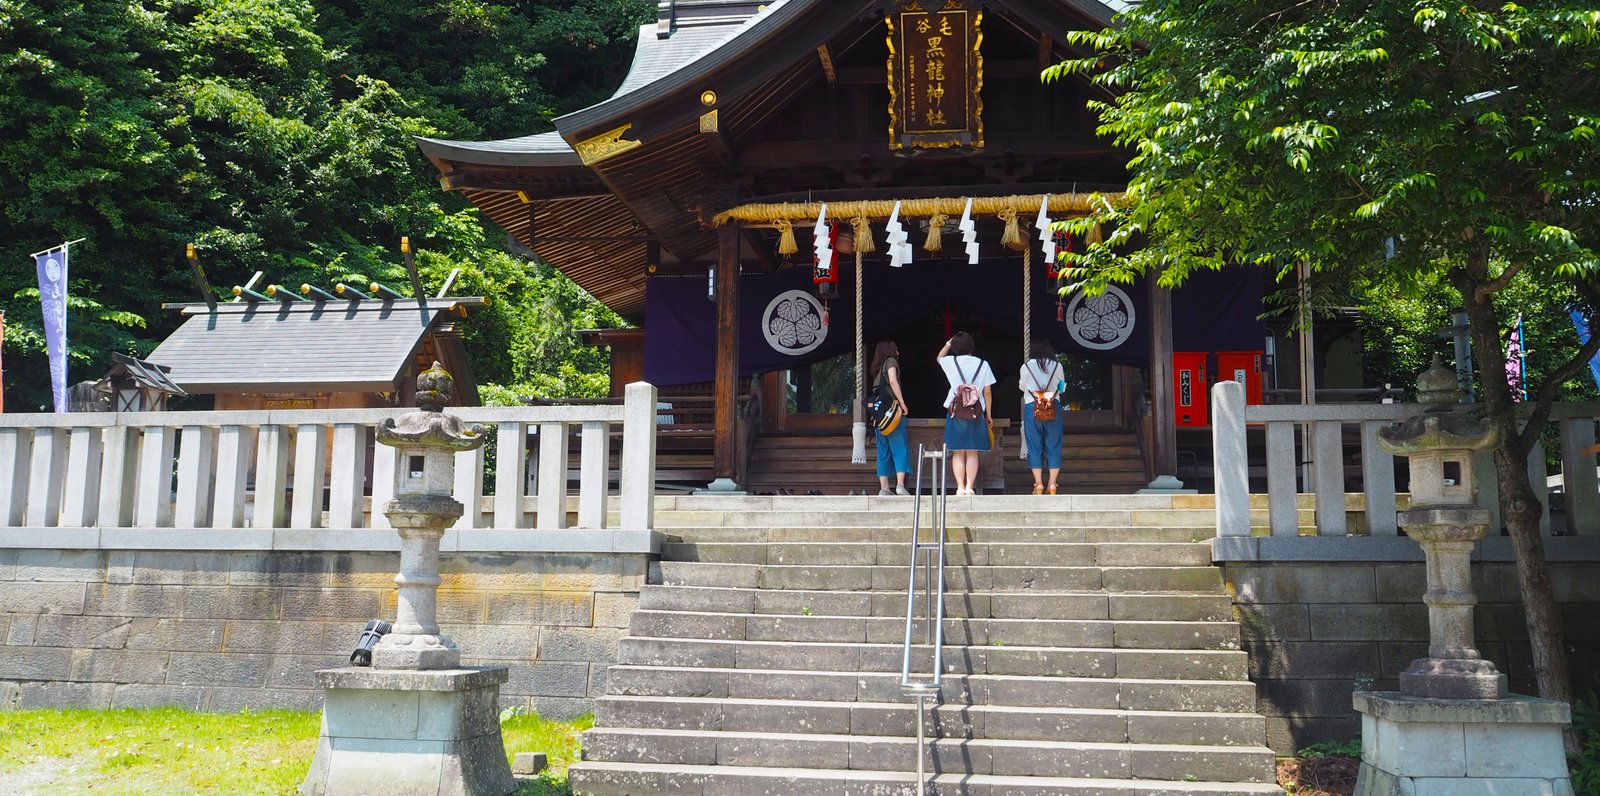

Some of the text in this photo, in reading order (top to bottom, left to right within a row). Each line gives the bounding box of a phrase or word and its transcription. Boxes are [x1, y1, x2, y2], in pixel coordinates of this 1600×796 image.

[925, 36, 947, 127] 黒龍神社
[1182, 371, 1190, 405] おみくじ
